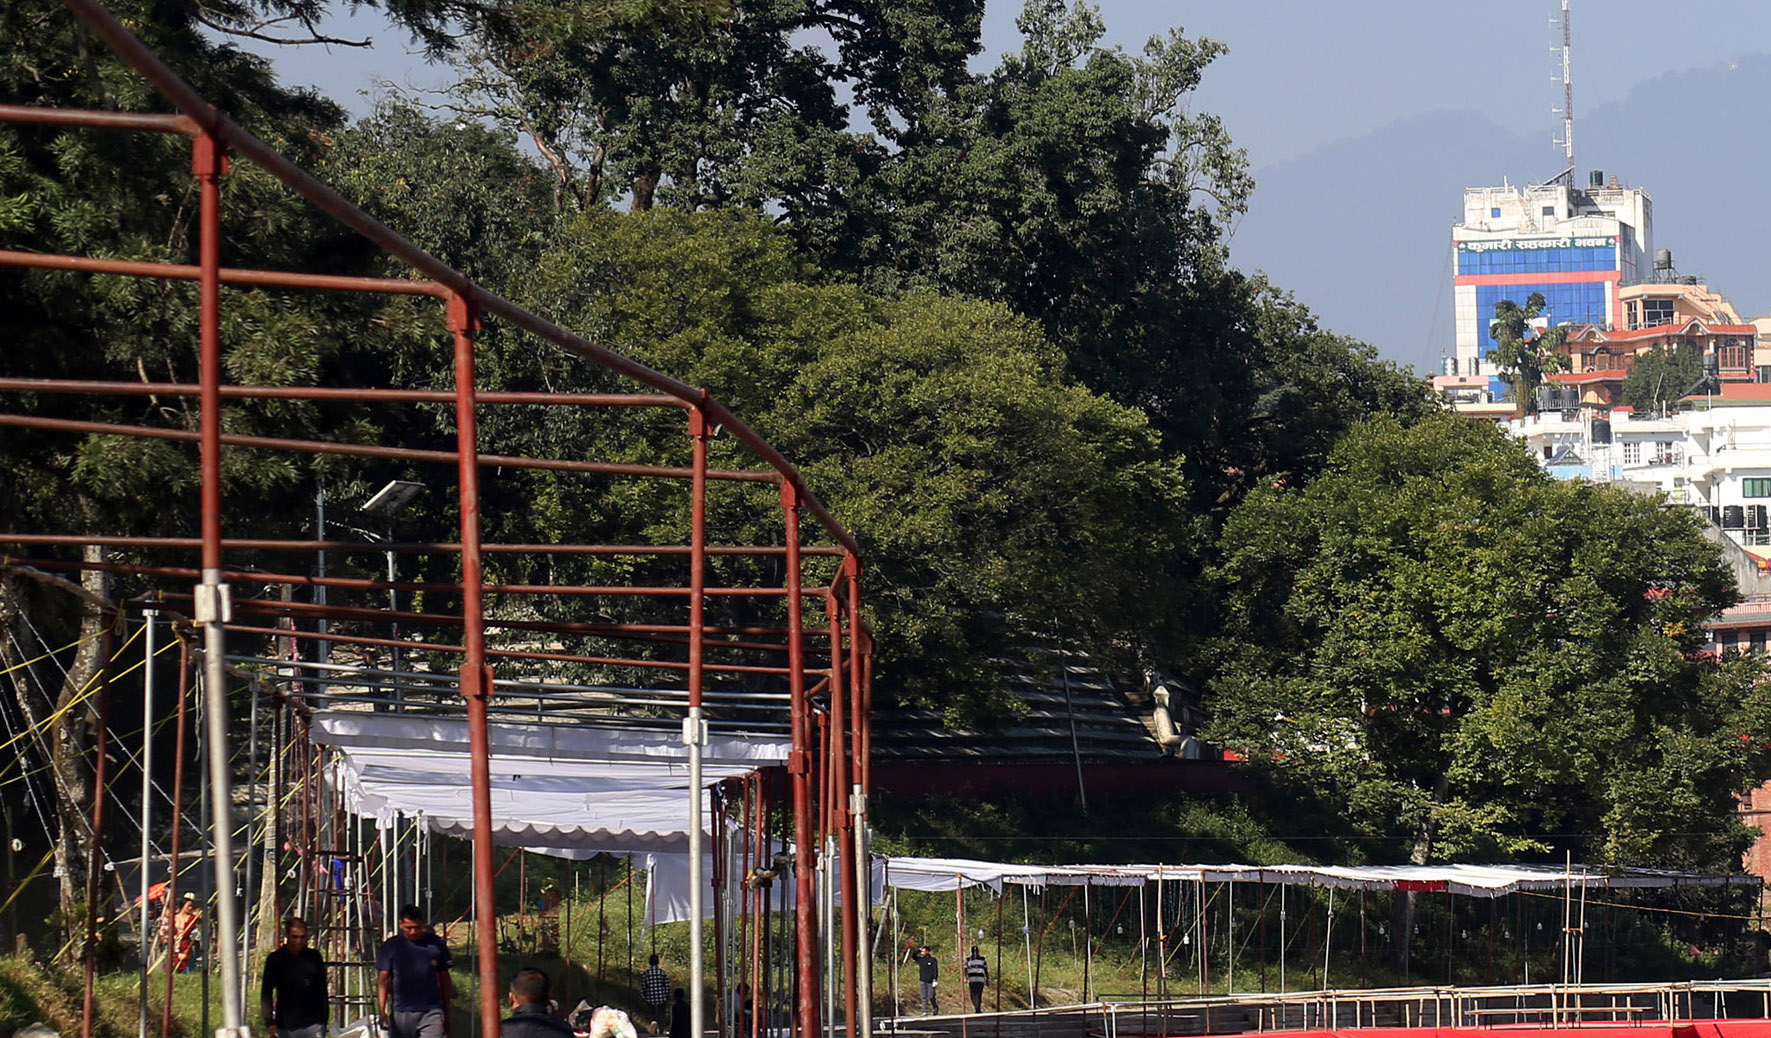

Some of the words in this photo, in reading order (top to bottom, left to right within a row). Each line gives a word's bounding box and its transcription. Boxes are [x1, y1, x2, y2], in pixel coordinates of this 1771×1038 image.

[1467, 239, 1512, 253] कुमारी
[1515, 237, 1571, 250] सहकारी
[1574, 237, 1607, 247] भवन
